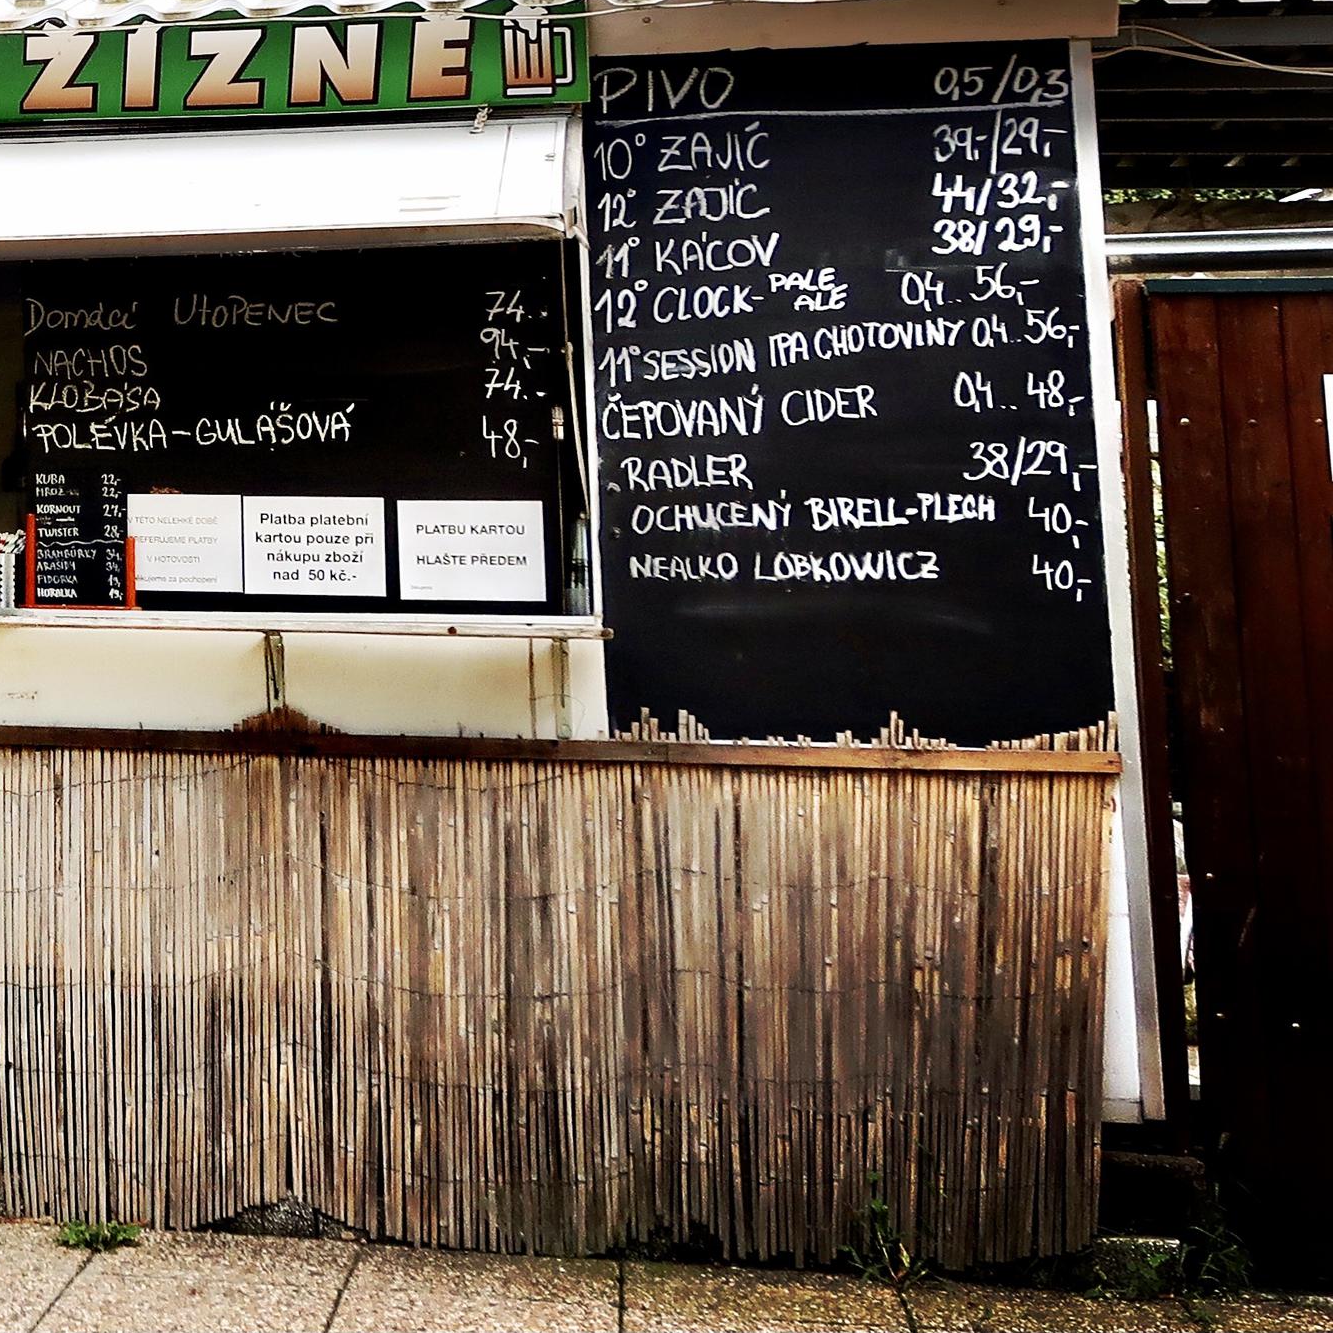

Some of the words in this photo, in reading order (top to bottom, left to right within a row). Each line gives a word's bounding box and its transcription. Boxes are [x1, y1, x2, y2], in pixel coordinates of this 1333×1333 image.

[19, 7, 475, 115] ŽÍZNĚ
[594, 67, 734, 114] PIVO
[655, 231, 780, 276] KÁCOV
[768, 268, 836, 294] PALE
[793, 280, 848, 312] ALE
[34, 344, 148, 380] NACHOS
[643, 337, 757, 381] SESSION
[769, 331, 810, 367] IPA
[814, 316, 966, 361] CHOTOVINY
[28, 380, 162, 414] KLOBÁSA
[601, 383, 765, 441] ČEPOVANÝ
[781, 384, 879, 427] CIDER
[36, 473, 66, 485] KUBA
[620, 453, 754, 492] RADLER
[36, 504, 82, 515] KORNOUT
[259, 512, 306, 526] Platba
[309, 513, 369, 529] platební
[37, 527, 80, 538] TWISTER
[255, 531, 302, 545] kartou
[306, 534, 350, 547] pouze
[355, 532, 375, 548] při
[415, 523, 467, 536] PLATBU
[470, 524, 526, 536] KARTOU
[266, 550, 321, 565] nákupu
[324, 550, 364, 564] zboží
[416, 552, 467, 566] HLAŠTE
[471, 553, 528, 567] PŘEDEM
[629, 552, 739, 582] NEALKO
[753, 549, 940, 583] LOBKOWICZ
[272, 568, 300, 582] nad
[308, 569, 326, 582] 50
